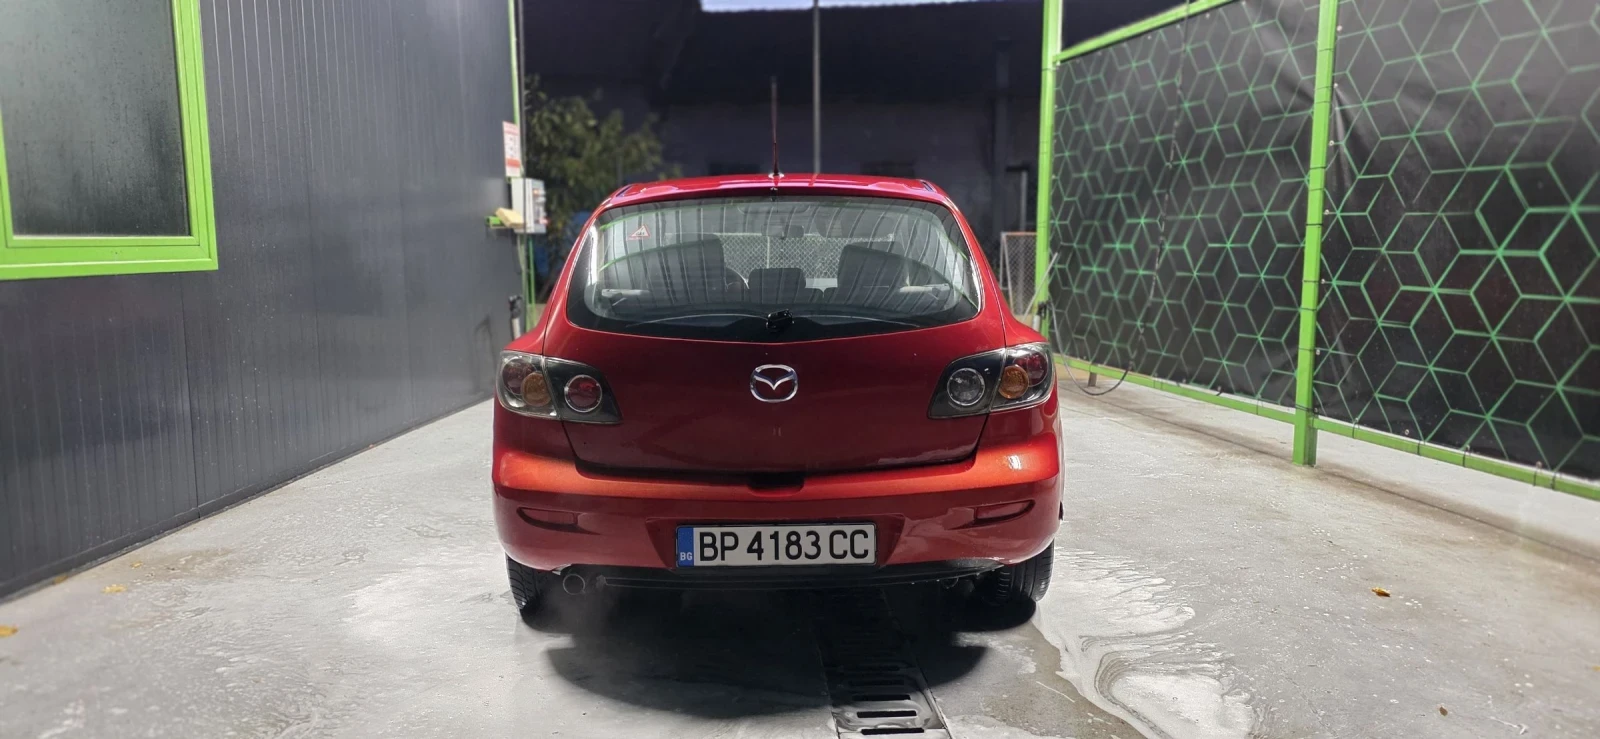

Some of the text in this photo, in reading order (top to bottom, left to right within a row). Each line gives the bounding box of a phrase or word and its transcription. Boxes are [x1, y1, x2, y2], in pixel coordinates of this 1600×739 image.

[699, 529, 869, 562] BP 4183 CC
[680, 552, 693, 561] BG
